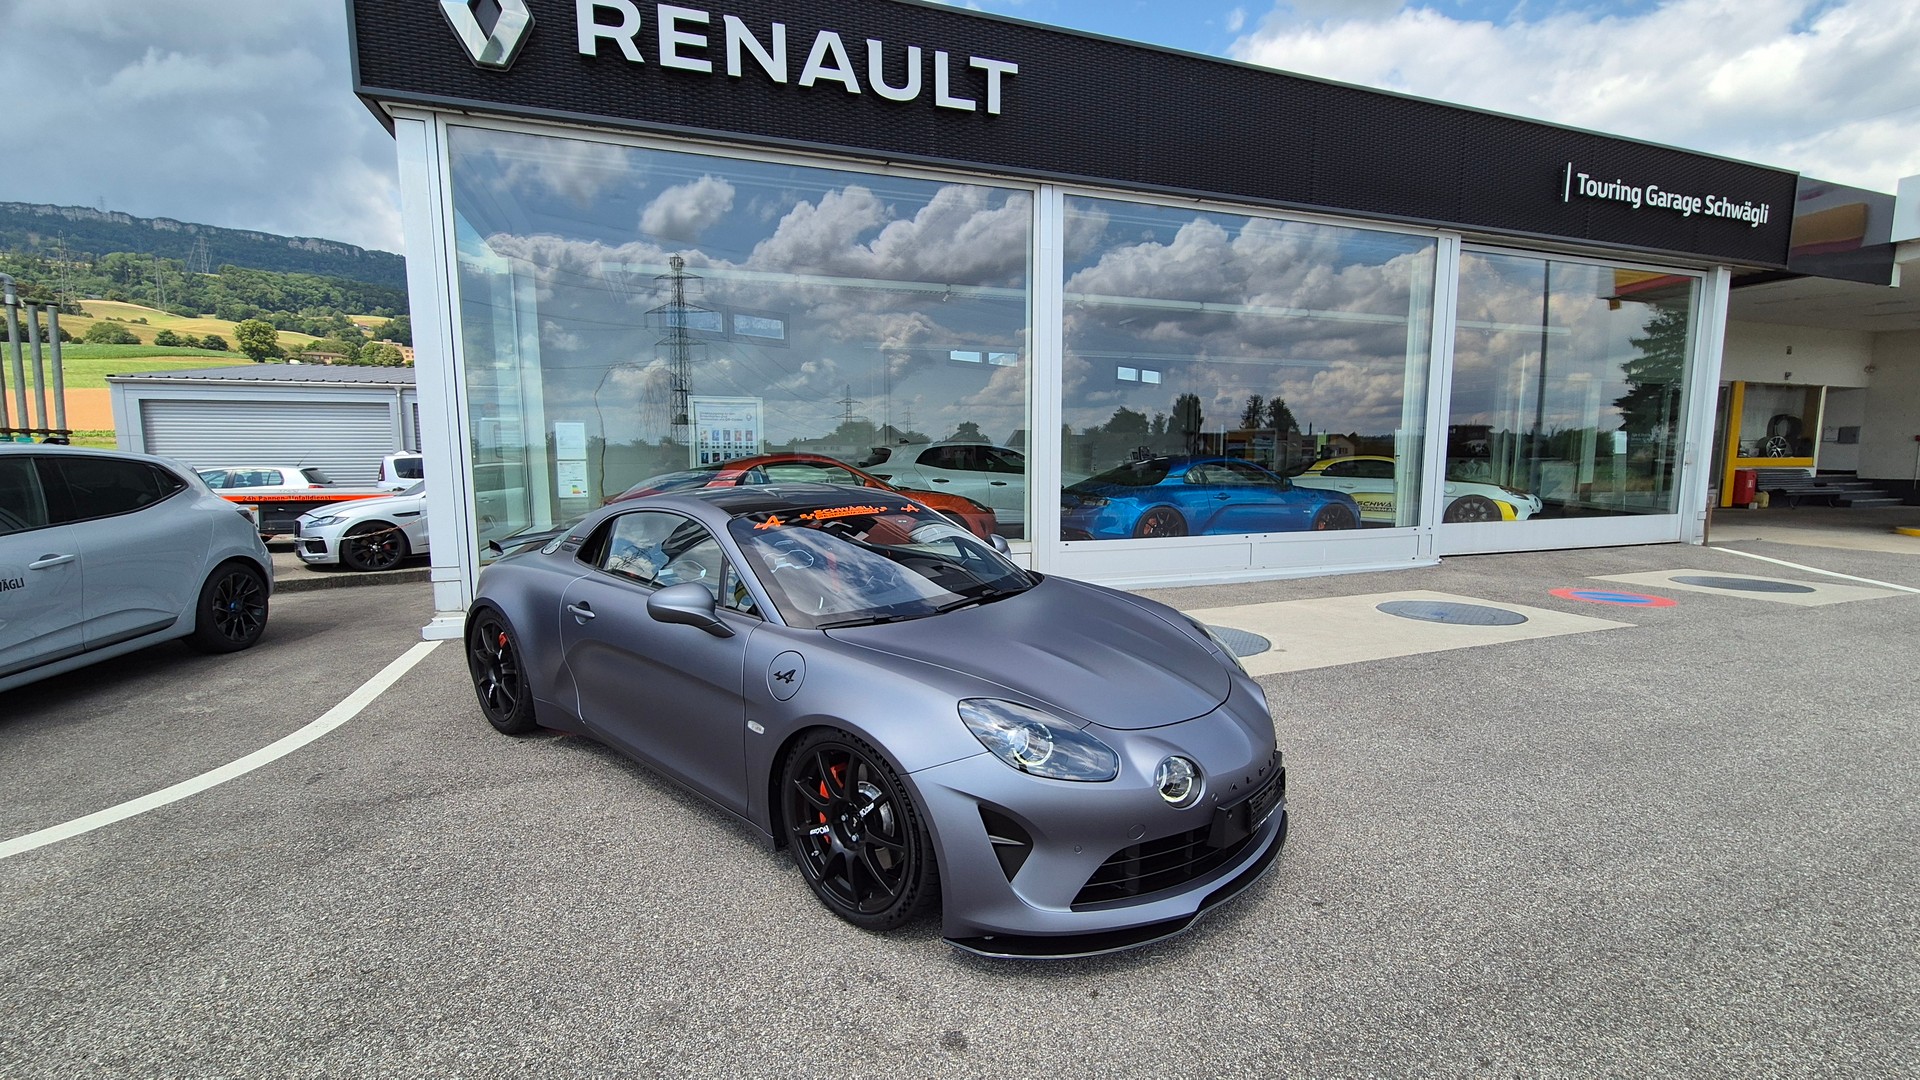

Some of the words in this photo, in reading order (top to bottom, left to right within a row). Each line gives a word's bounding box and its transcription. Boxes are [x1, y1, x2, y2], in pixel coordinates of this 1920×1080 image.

[576, 0, 1018, 115] RENAULT
[1577, 172, 1641, 209] Touring
[1645, 184, 1701, 217] Garage
[1704, 195, 1770, 228] Schwägli
[1357, 500, 1392, 508] SCHWA
[0, 577, 25, 592] ÄGLI
[889, 771, 917, 825] MICHELIN
